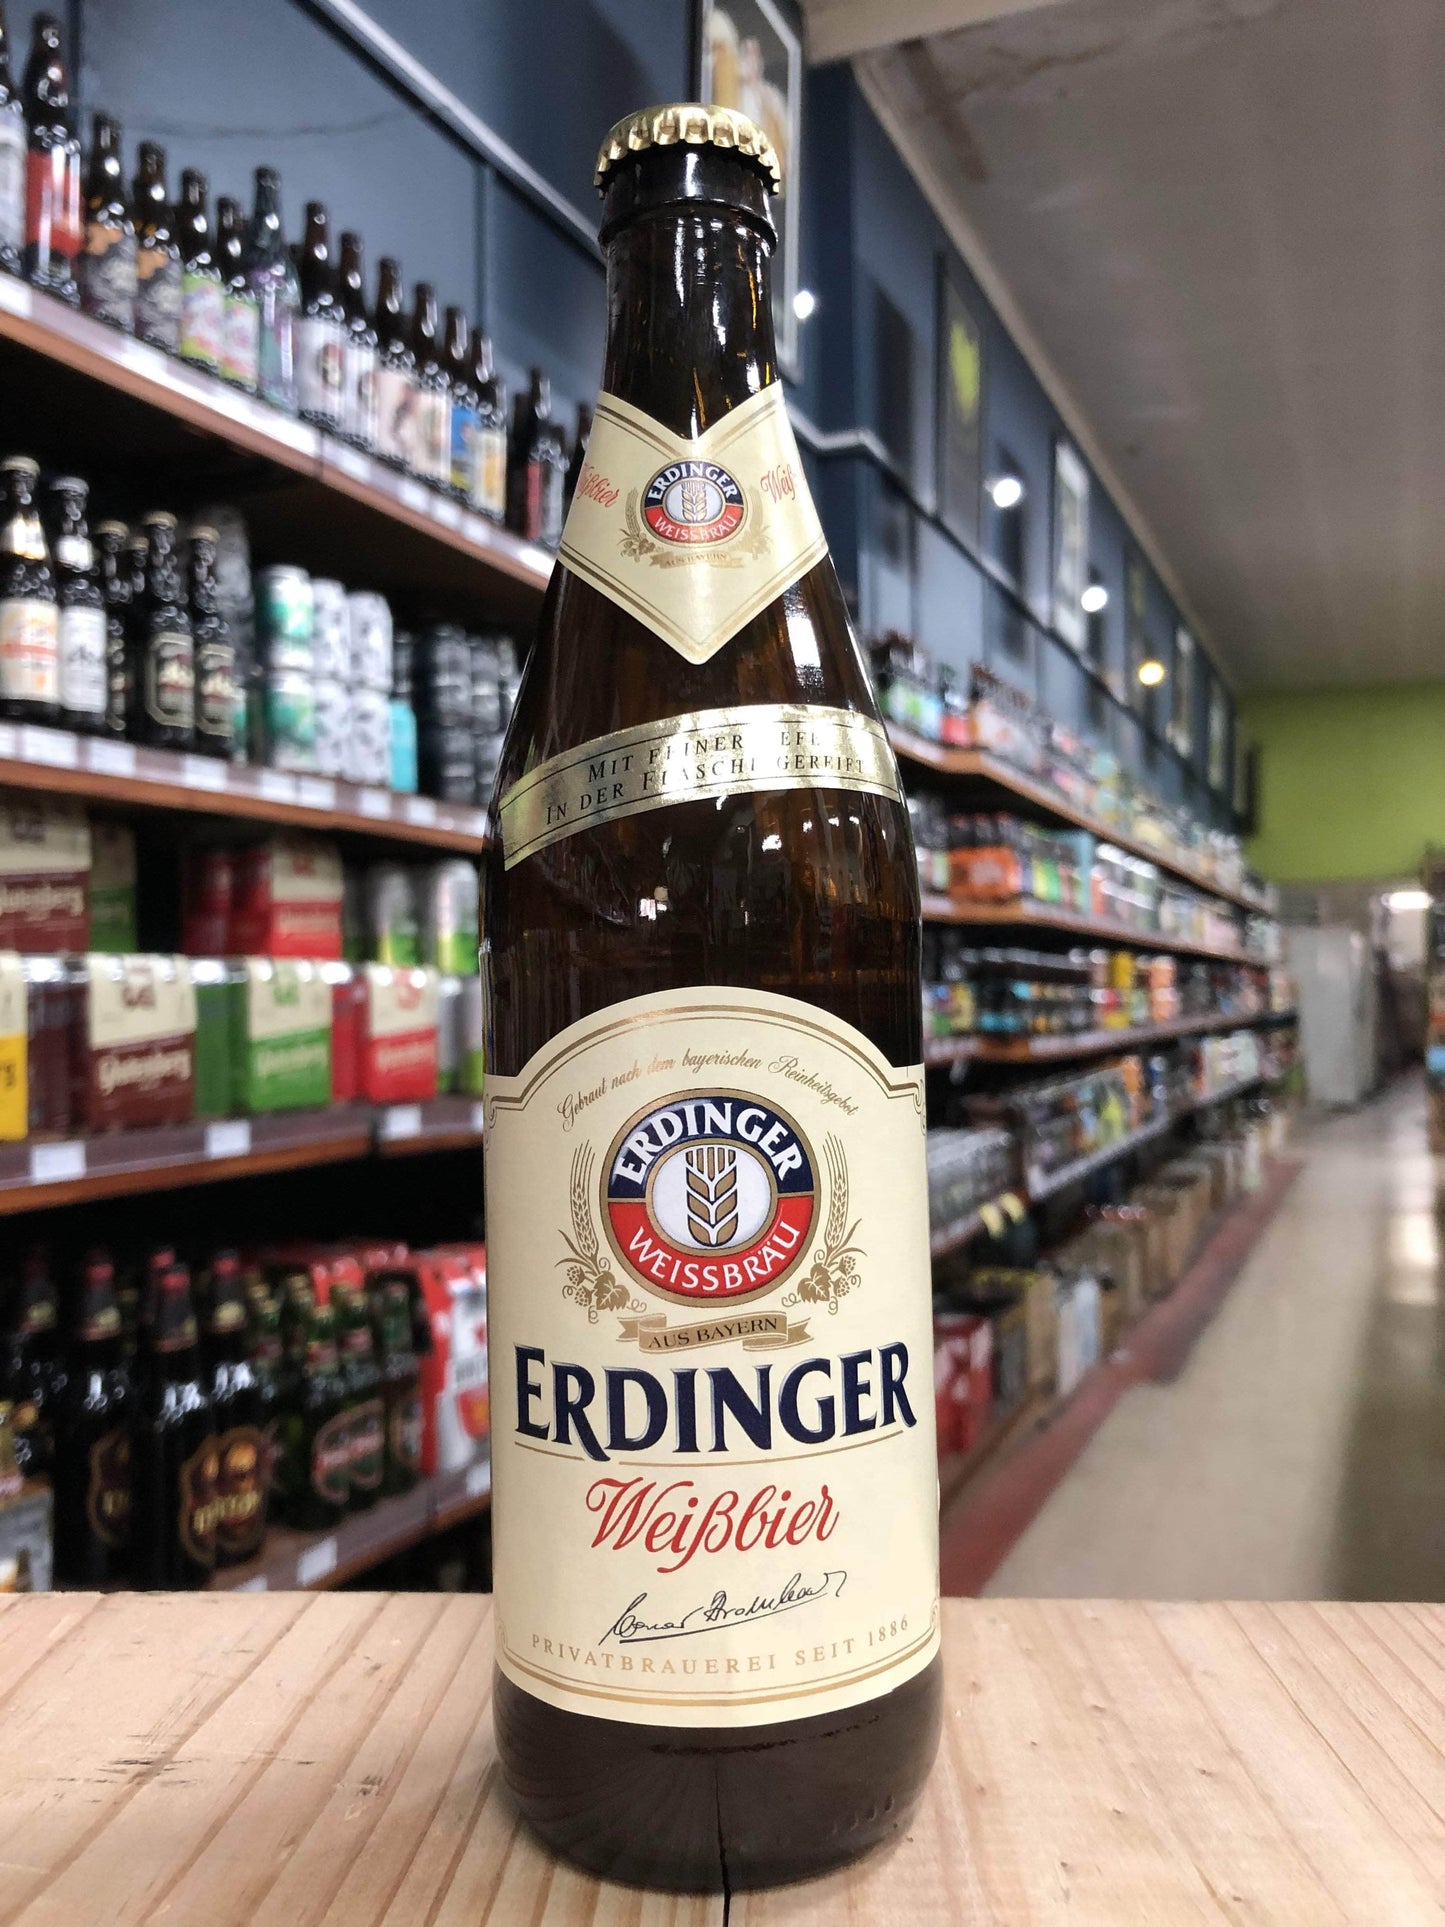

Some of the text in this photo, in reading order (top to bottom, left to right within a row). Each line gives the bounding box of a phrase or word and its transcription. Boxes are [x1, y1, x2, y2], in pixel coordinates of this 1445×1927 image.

[648, 463, 739, 500] ERDINGER
[580, 782, 625, 811] DER
[588, 754, 634, 783] MIT
[556, 1077, 608, 1133] Gebraut
[610, 1060, 642, 1090] nach
[681, 1047, 763, 1074] bayerischen
[767, 1055, 861, 1117] Reinheitsgebot
[613, 1101, 804, 1187] ERDINGER
[628, 1220, 801, 1292] WEISSBRÄU
[647, 1316, 780, 1350] AUS BAYERN
[513, 1341, 919, 1463] ERDINGER
[585, 1475, 841, 1574] Weißbier
[531, 1613, 911, 1676] PRIVATBRAUEREI SEIT 1886
